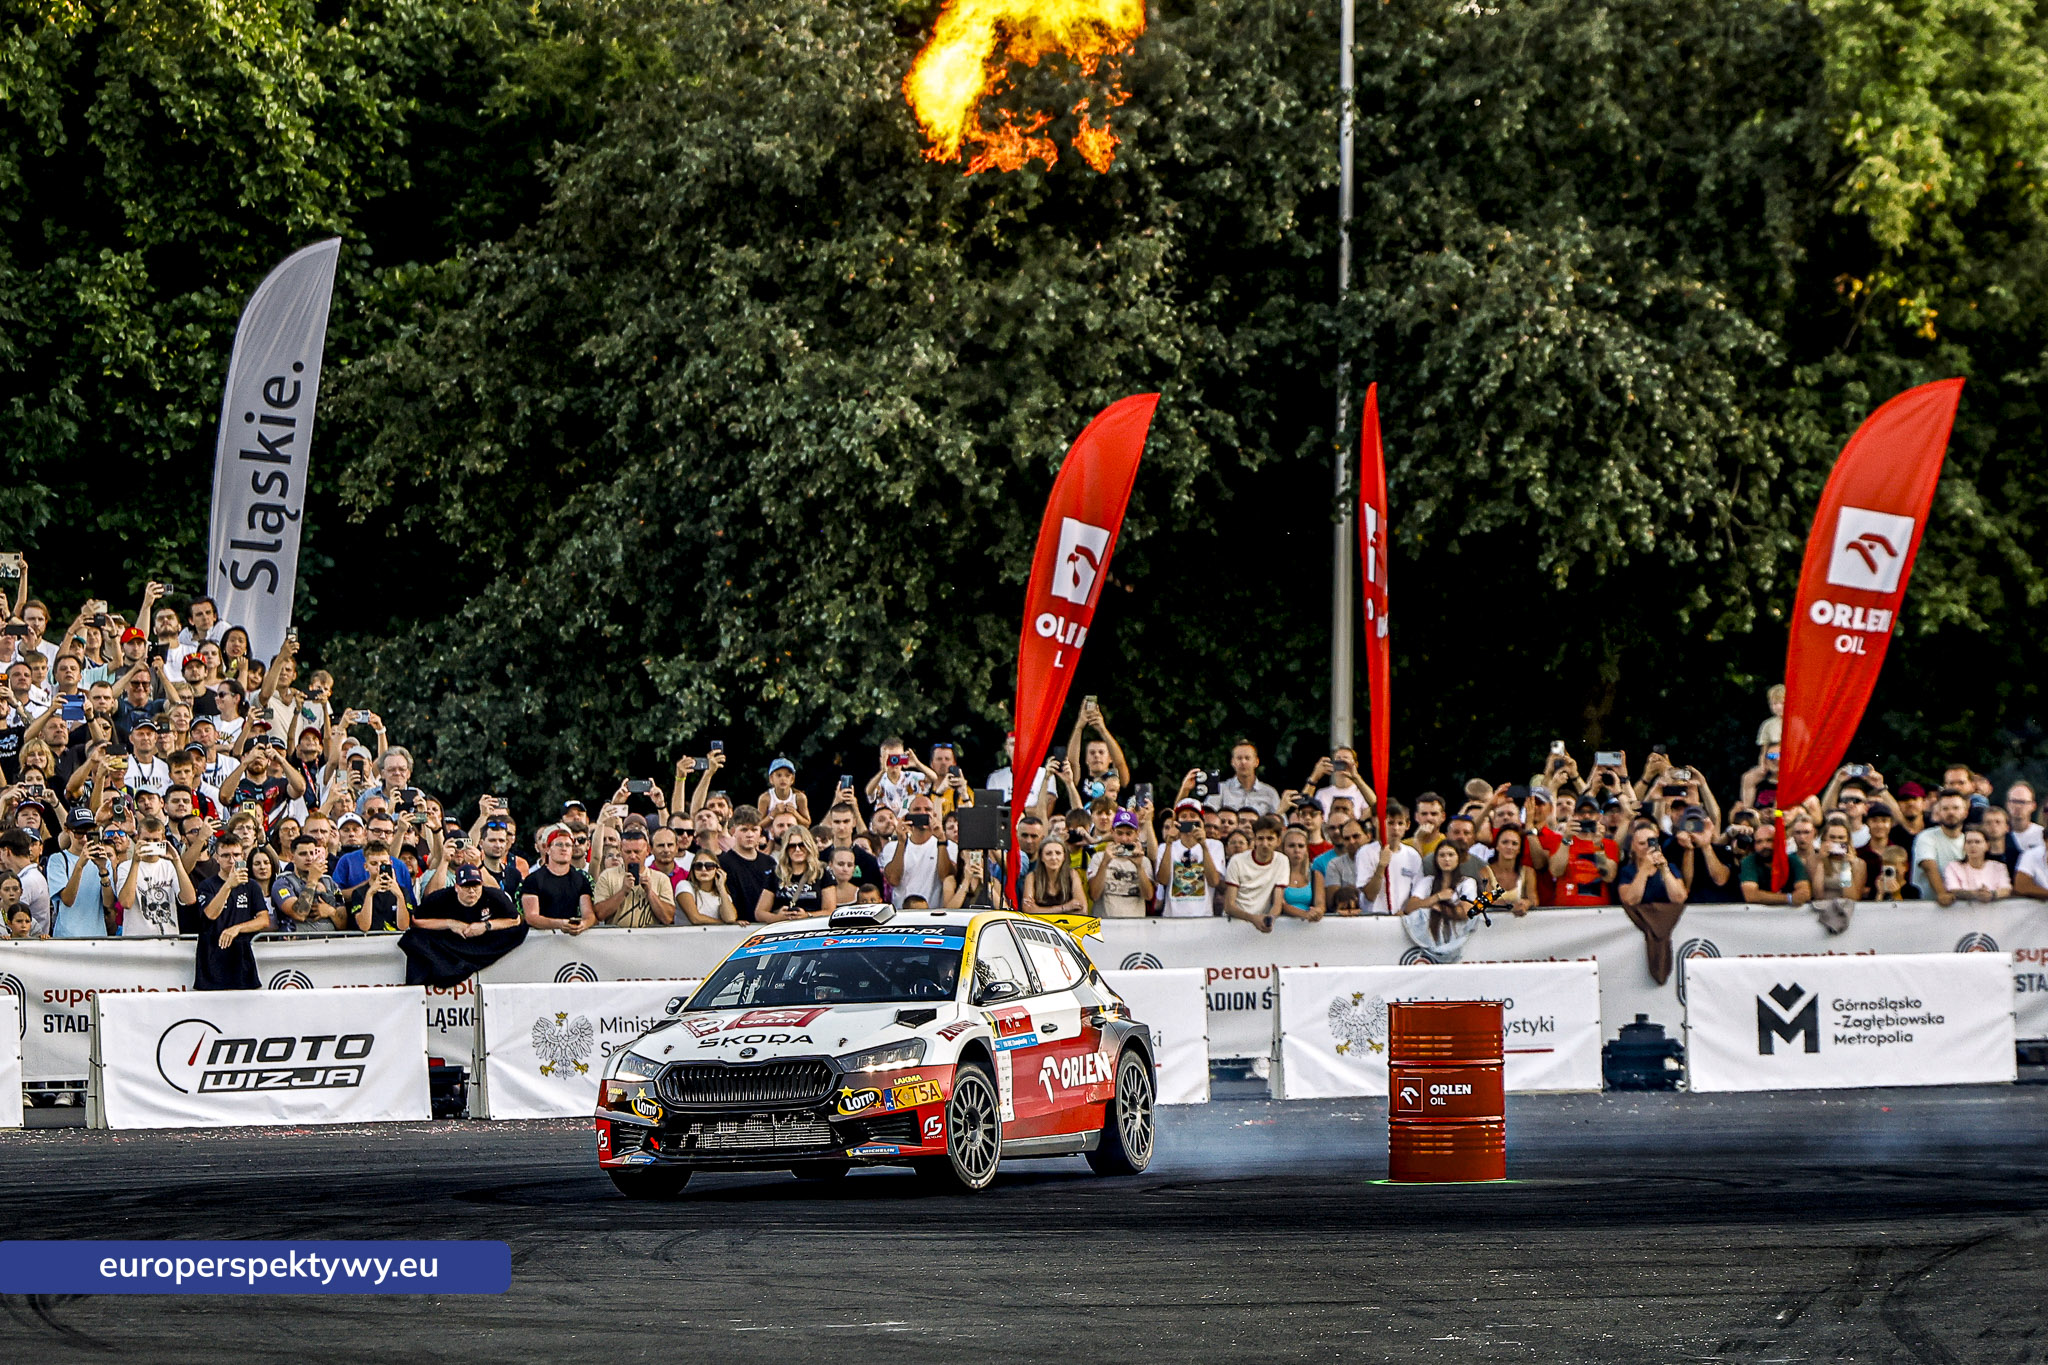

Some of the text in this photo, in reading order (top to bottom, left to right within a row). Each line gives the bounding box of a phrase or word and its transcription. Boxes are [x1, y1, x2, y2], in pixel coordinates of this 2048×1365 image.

[219, 360, 305, 595] Śląskie.
[1834, 633, 1867, 656] OIL
[833, 909, 877, 918] GLIWICE
[743, 927, 946, 948] 8 evotech.com.pl
[2016, 949, 2048, 967] sup
[2016, 973, 2048, 992] STA
[1832, 996, 1922, 1013] Górnośląsko
[43, 1014, 89, 1033] STAD
[600, 1015, 657, 1034] Minist
[740, 1017, 801, 1026] ORLEN
[1503, 1015, 1555, 1037] ystyki
[1834, 1012, 1945, 1031] -Zagłębiowska
[1834, 1031, 1914, 1047] Metropolia
[207, 1034, 375, 1065] MOTO
[202, 1068, 360, 1091] WIZJA
[1061, 1051, 1113, 1090] ORLEN
[893, 1083, 940, 1107] K T5A
[1429, 1084, 1472, 1095] ORLEN
[636, 1098, 657, 1116] LOTTO
[844, 1092, 875, 1111] LOTTO
[1429, 1096, 1447, 1106] OIL
